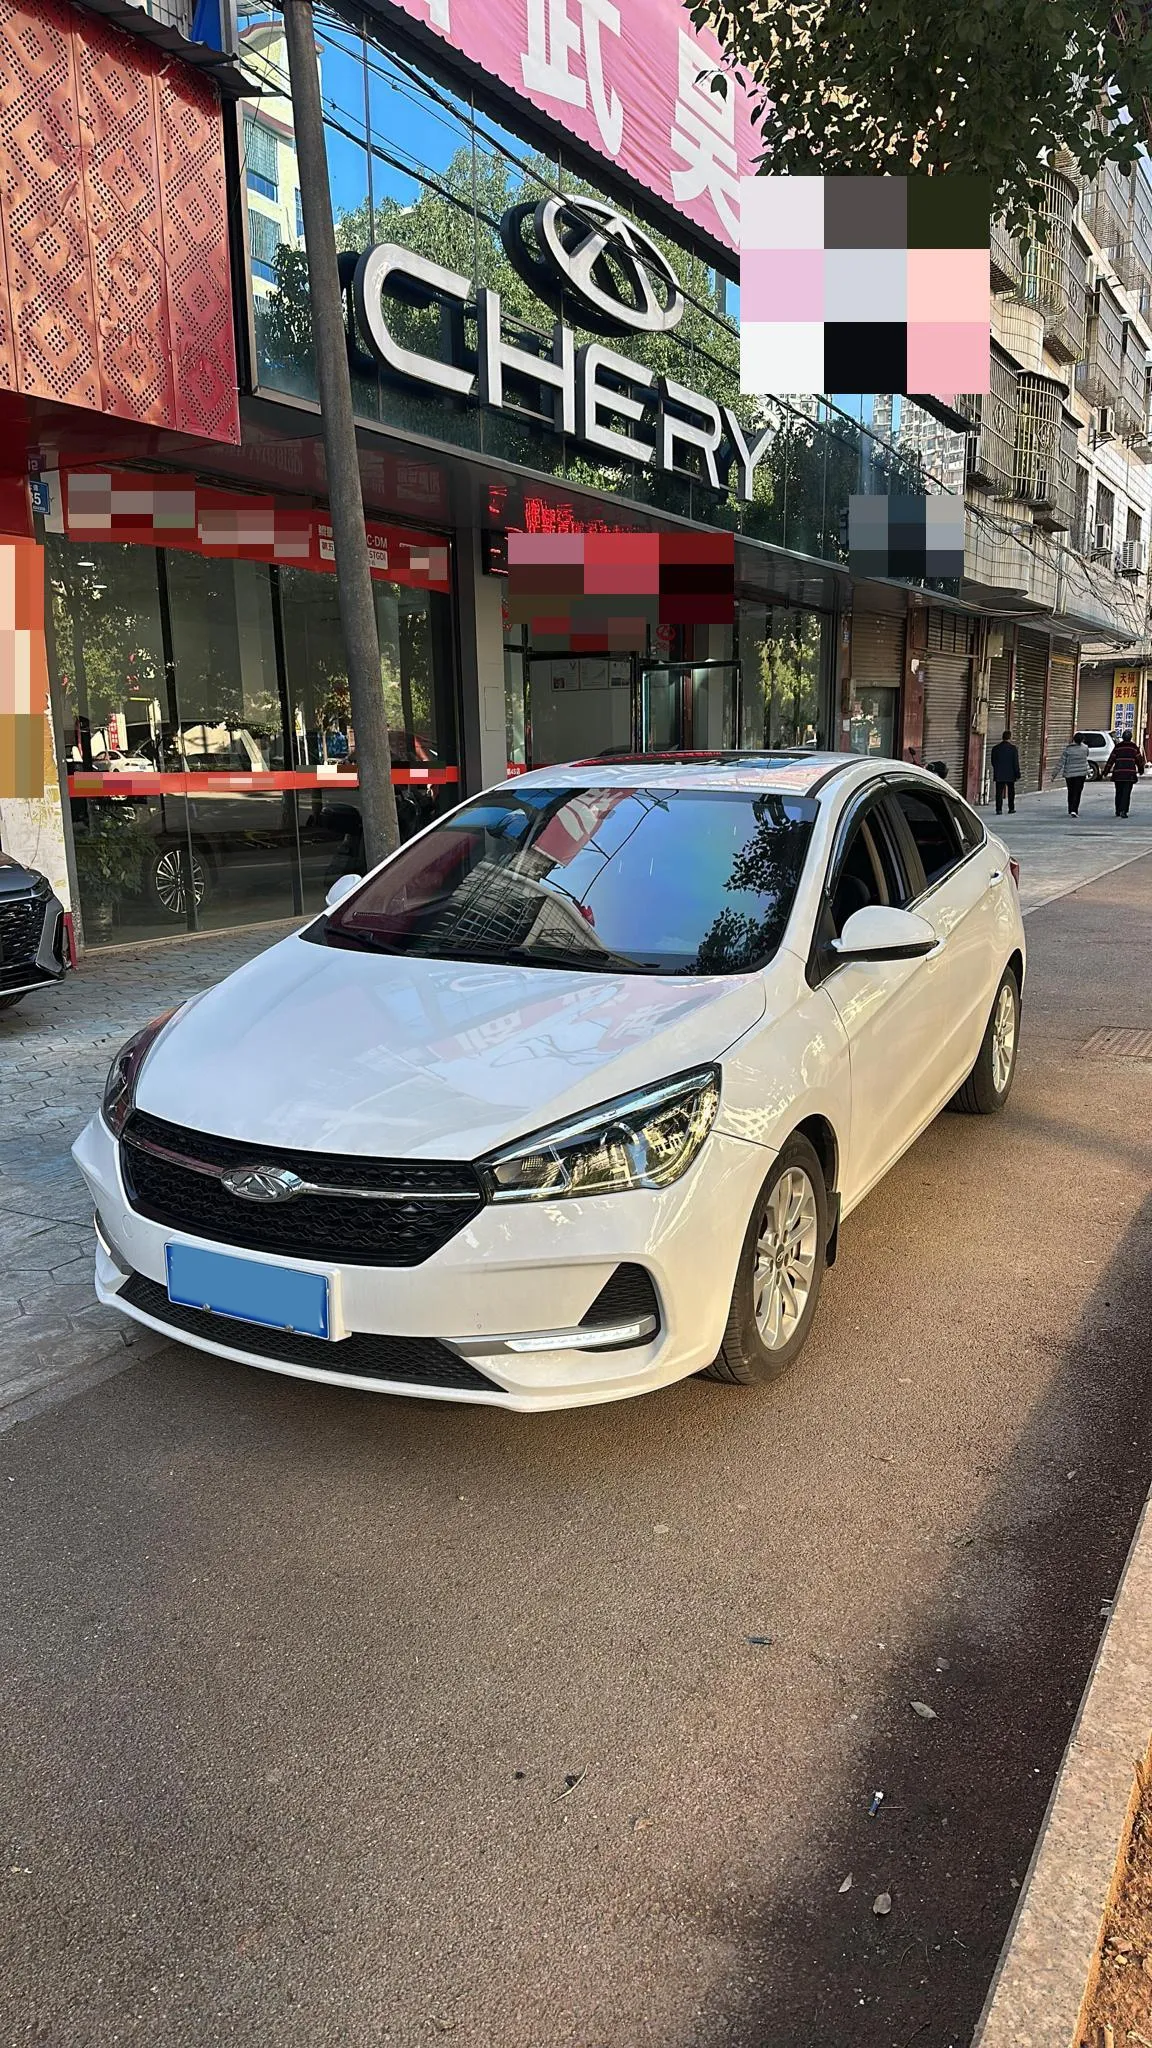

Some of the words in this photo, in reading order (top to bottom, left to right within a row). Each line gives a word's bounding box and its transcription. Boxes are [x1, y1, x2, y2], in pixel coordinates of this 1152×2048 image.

[354, 242, 777, 501] CHERY
[1114, 686, 1138, 698] 便利店
